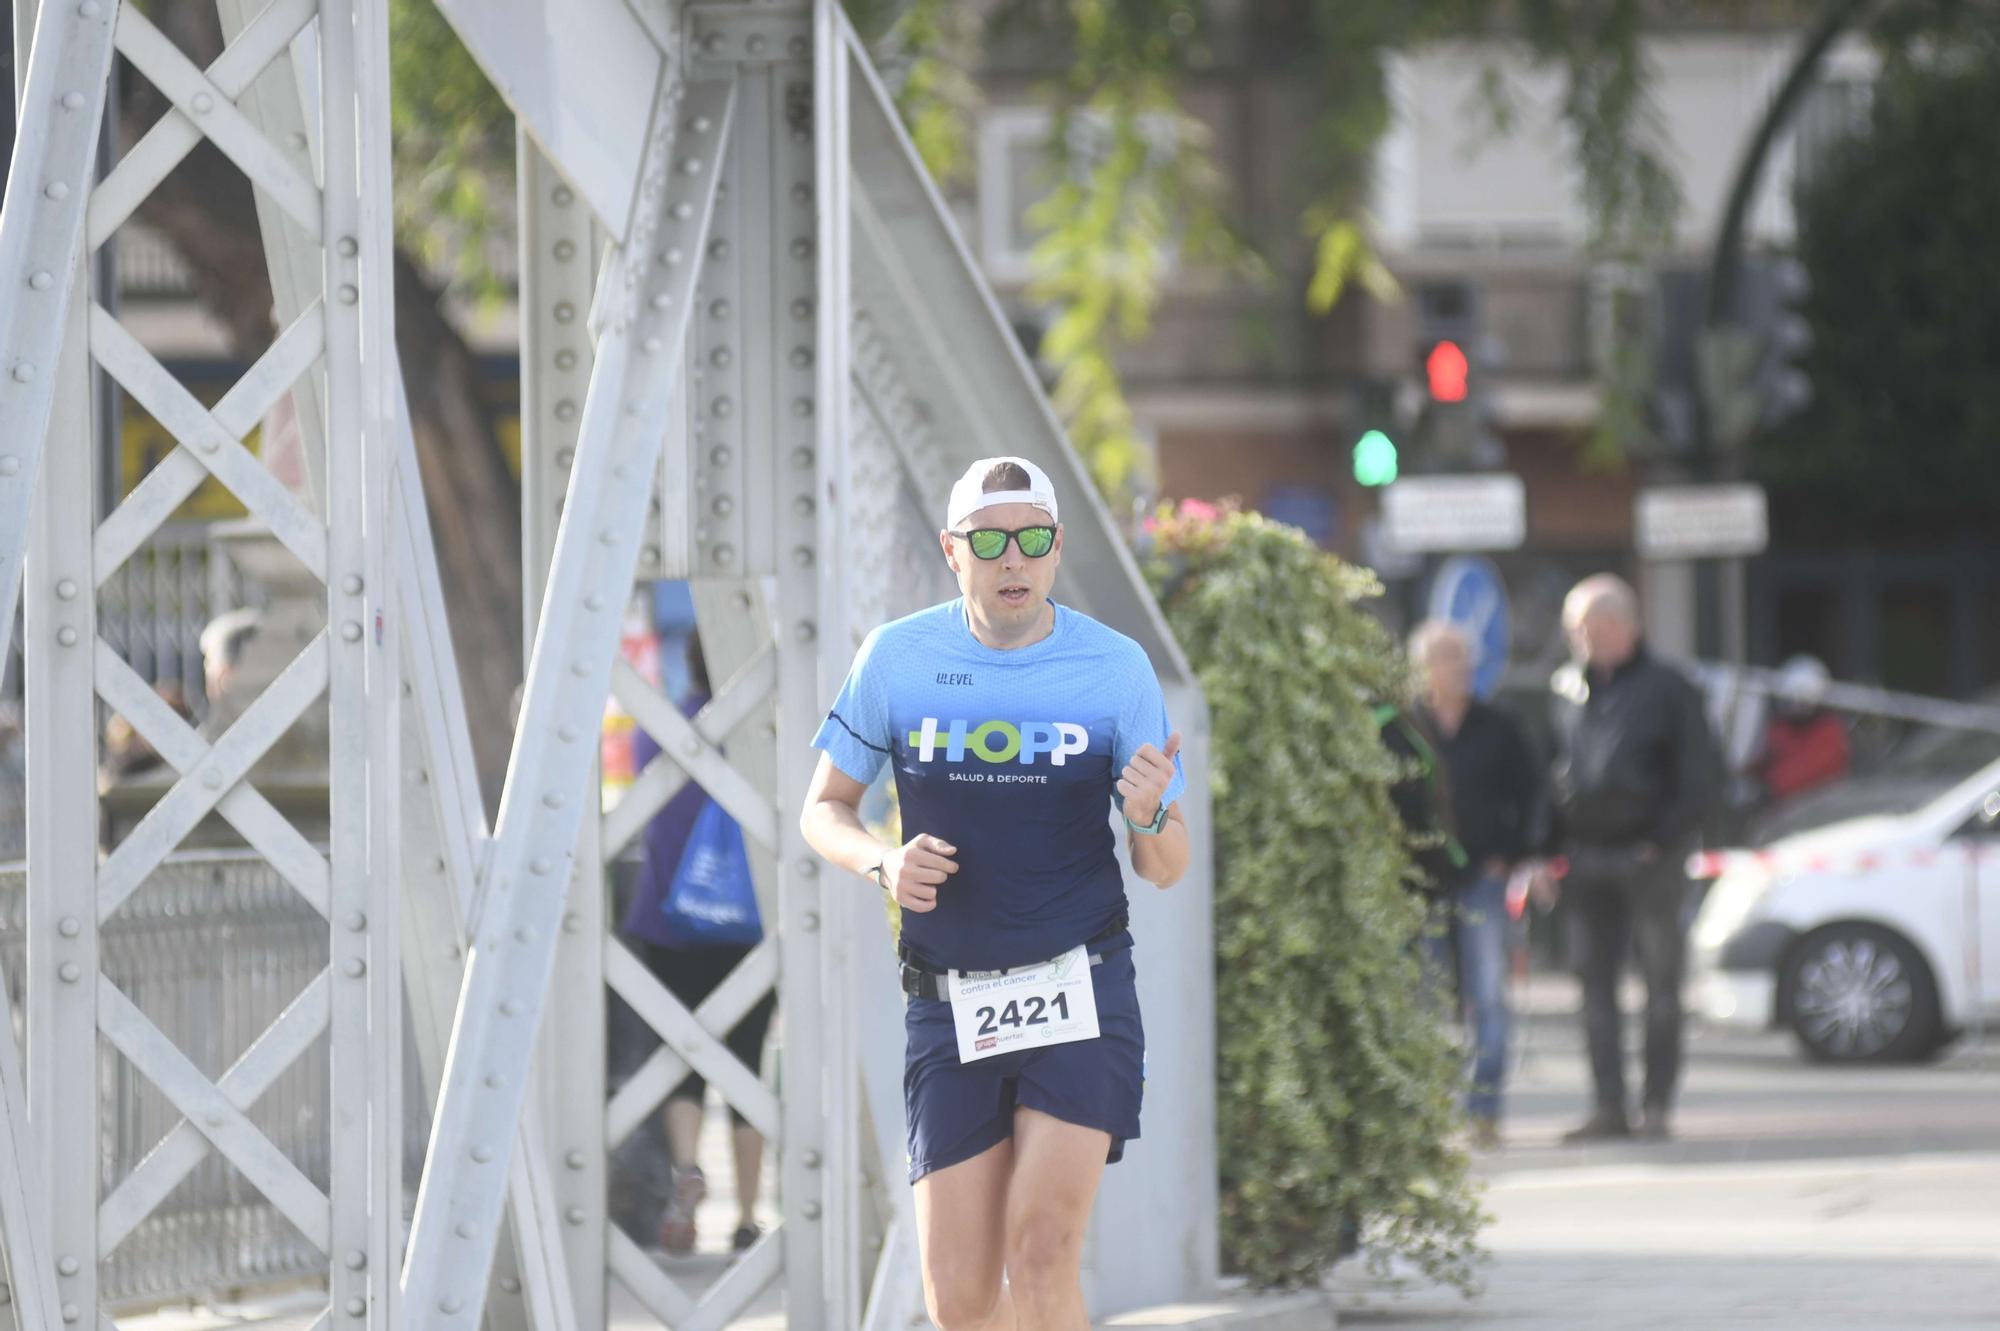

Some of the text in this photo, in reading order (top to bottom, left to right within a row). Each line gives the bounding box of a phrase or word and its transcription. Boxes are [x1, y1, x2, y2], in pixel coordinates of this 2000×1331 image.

[908, 717, 1089, 766] HOPP
[949, 773, 1047, 784] SALUD & DEPORTE
[961, 983, 990, 996] contra
[992, 977, 1002, 987] el
[976, 991, 1070, 1036] 2421
